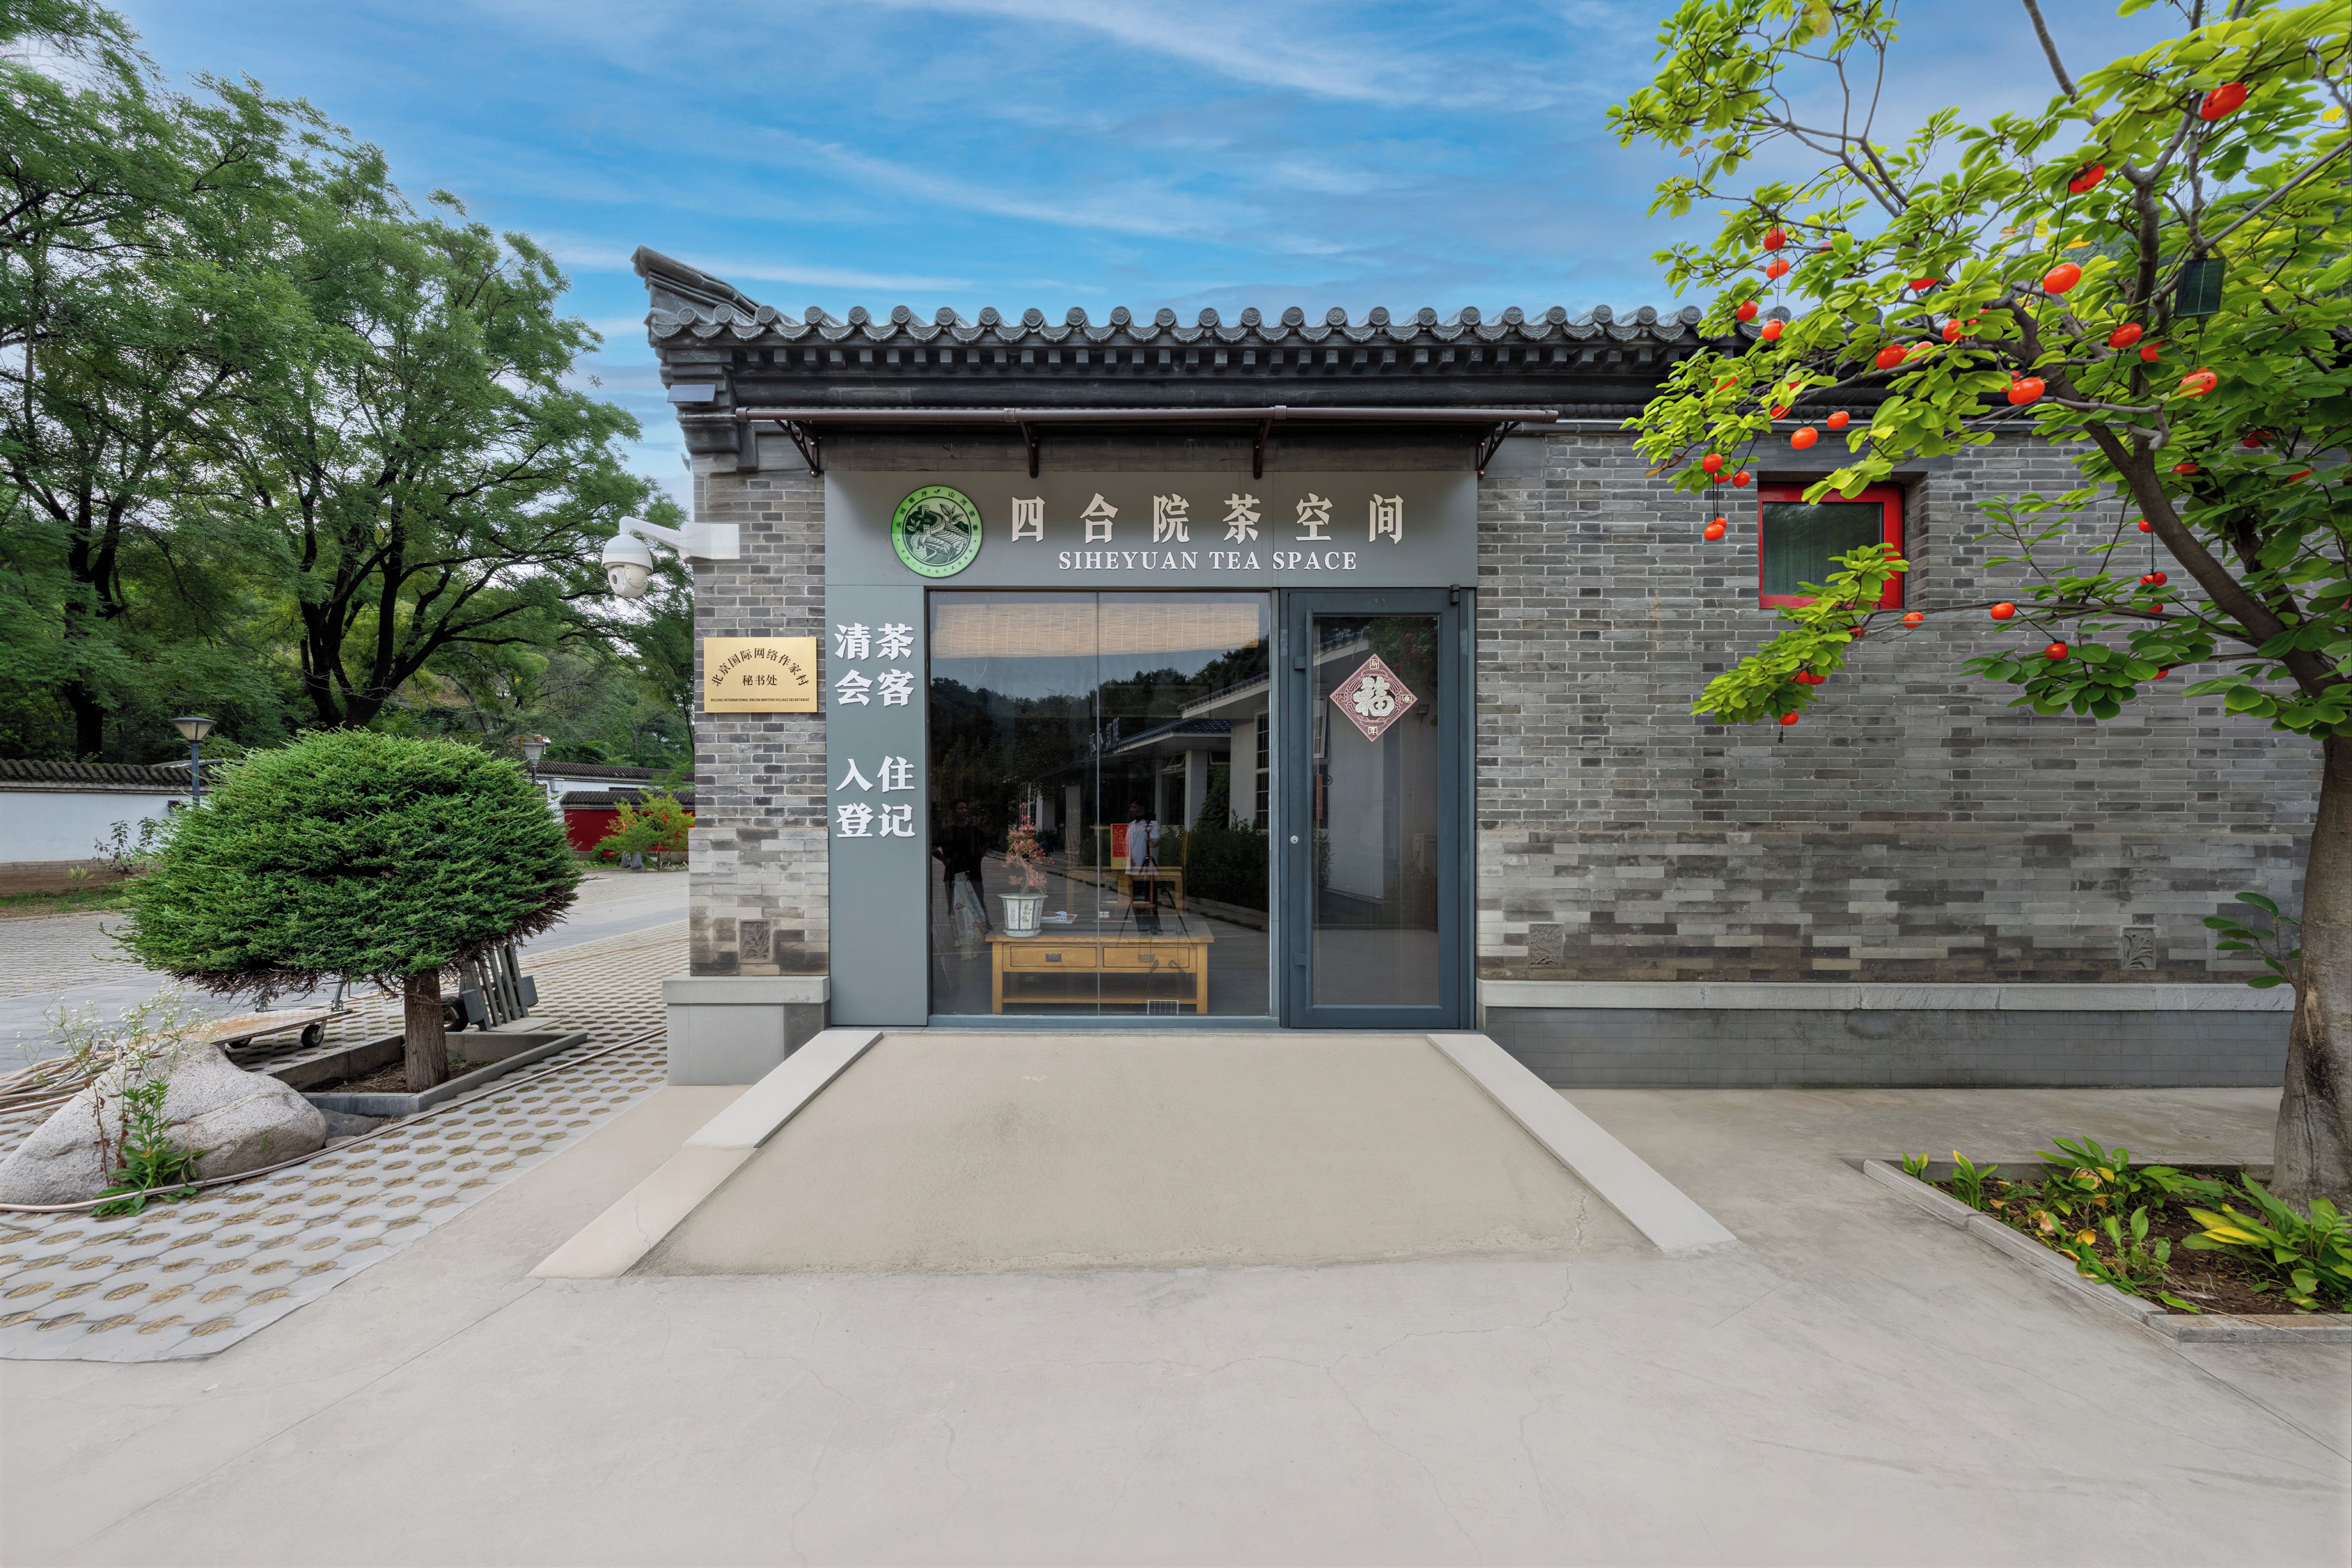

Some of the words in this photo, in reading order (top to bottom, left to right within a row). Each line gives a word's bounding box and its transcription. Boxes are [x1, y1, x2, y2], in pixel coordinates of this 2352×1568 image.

[1011, 492, 1404, 545] 四合院茶空间
[1058, 551, 1198, 570] SIHEYUAN
[1209, 551, 1261, 570] TEA
[1272, 551, 1357, 570] SPACE
[834, 622, 915, 661] 清茶
[711, 647, 809, 687] 北京国际网络作家村
[742, 674, 777, 686] 秘书处
[834, 668, 916, 706] 会客
[1352, 676, 1395, 717] 福
[836, 755, 916, 793] 入住
[836, 802, 916, 838] 登记
